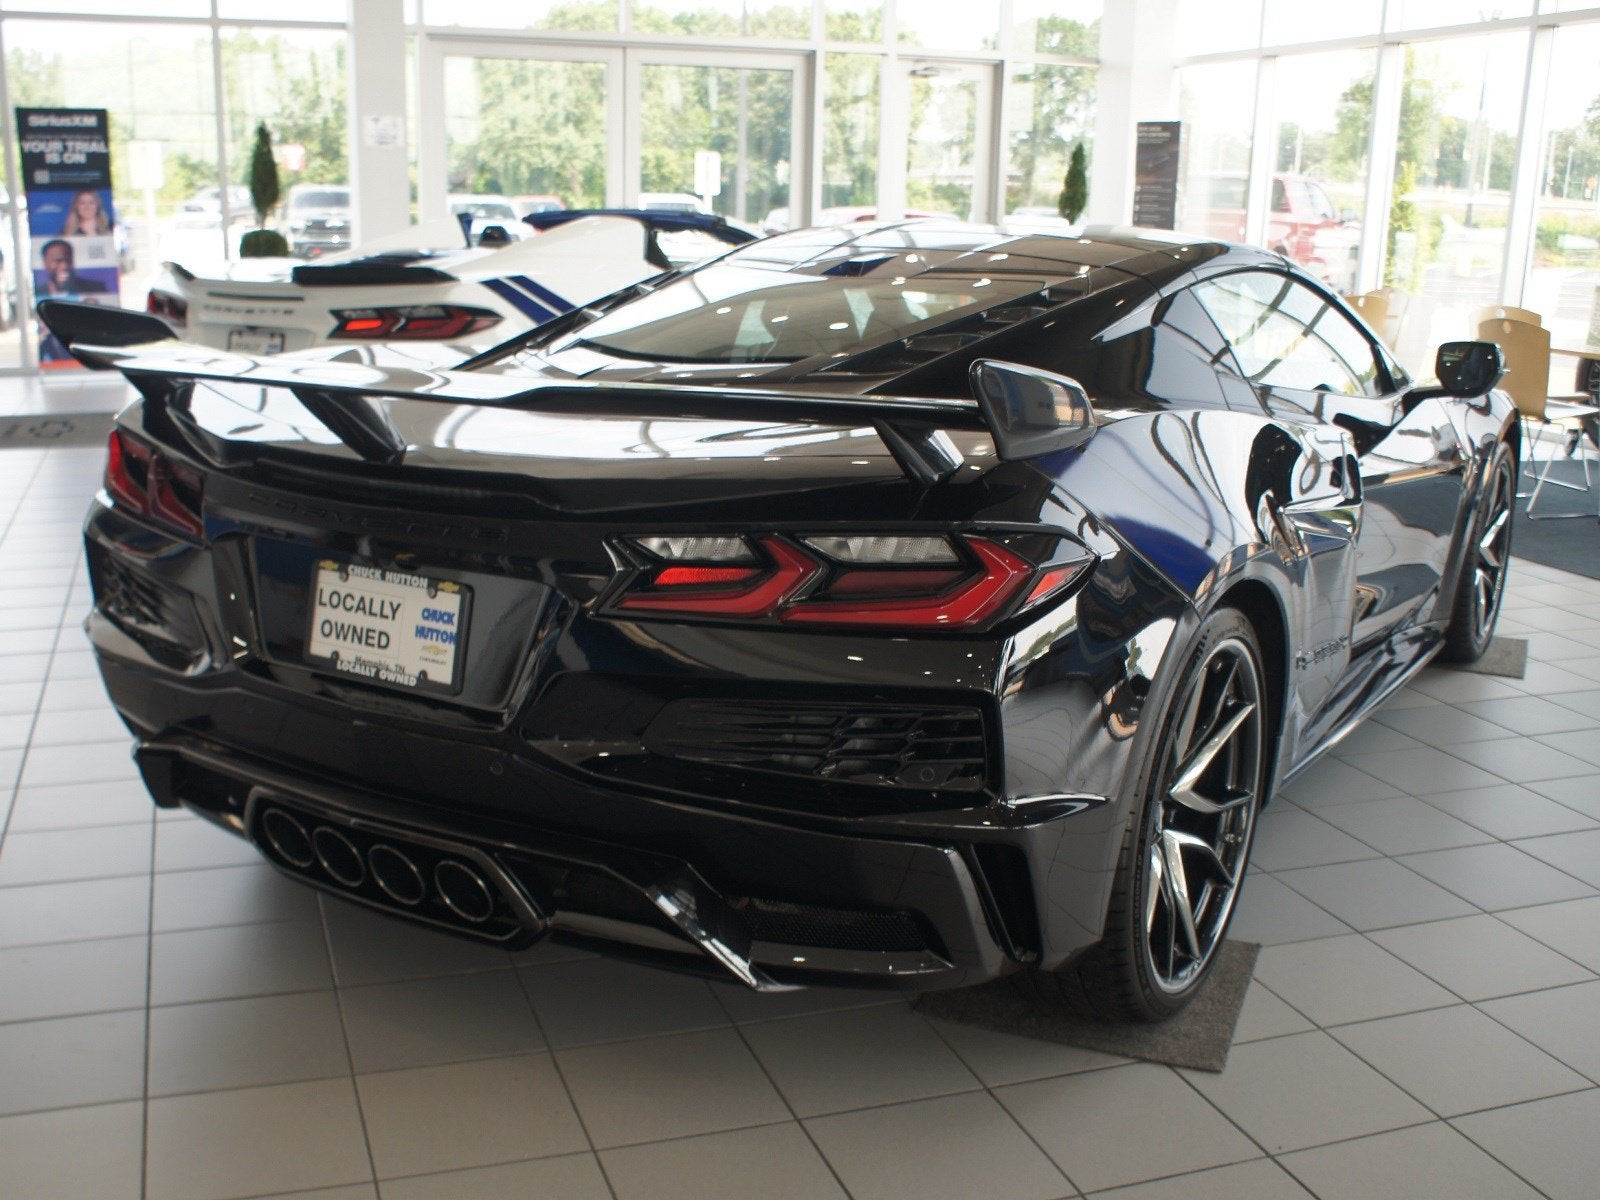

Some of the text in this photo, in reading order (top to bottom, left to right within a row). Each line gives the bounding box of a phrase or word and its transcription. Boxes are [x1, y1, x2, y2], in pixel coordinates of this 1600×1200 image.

[21, 140, 108, 153] YOUR TRIAL
[45, 152, 87, 164] IS ON
[347, 564, 429, 588] CHUCK HUTTON
[318, 588, 402, 621] LOCALLY
[421, 607, 455, 626] CHUCK
[321, 619, 390, 650] OWNED
[415, 625, 457, 645] HUTTON
[336, 660, 417, 687] LOCALLY OWNED
